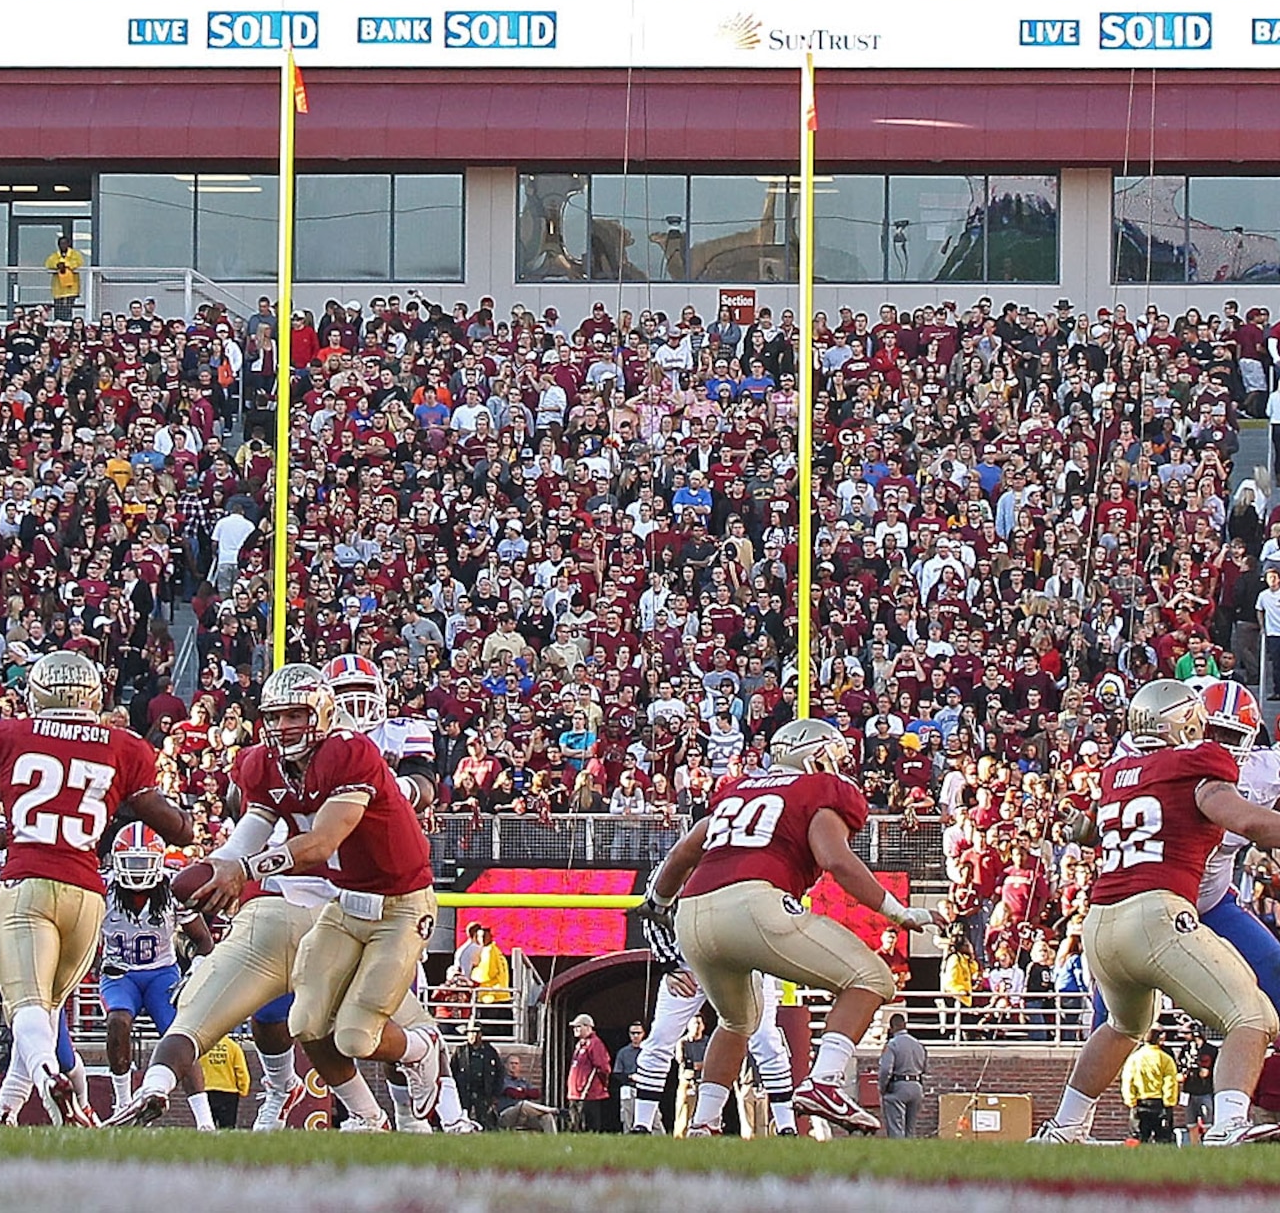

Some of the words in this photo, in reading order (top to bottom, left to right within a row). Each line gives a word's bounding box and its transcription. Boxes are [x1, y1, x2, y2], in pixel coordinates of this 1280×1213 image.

[131, 20, 187, 44] LIVE
[209, 13, 318, 48] SOLID
[360, 18, 431, 42] BANK
[446, 13, 555, 47] SOLID
[1021, 20, 1078, 44] LIVE
[1101, 14, 1210, 48] SOLID
[721, 294, 754, 307] Section
[32, 719, 110, 745] THOMPSON
[10, 751, 117, 852] 23
[702, 793, 785, 851] 60
[1096, 795, 1165, 874] 52
